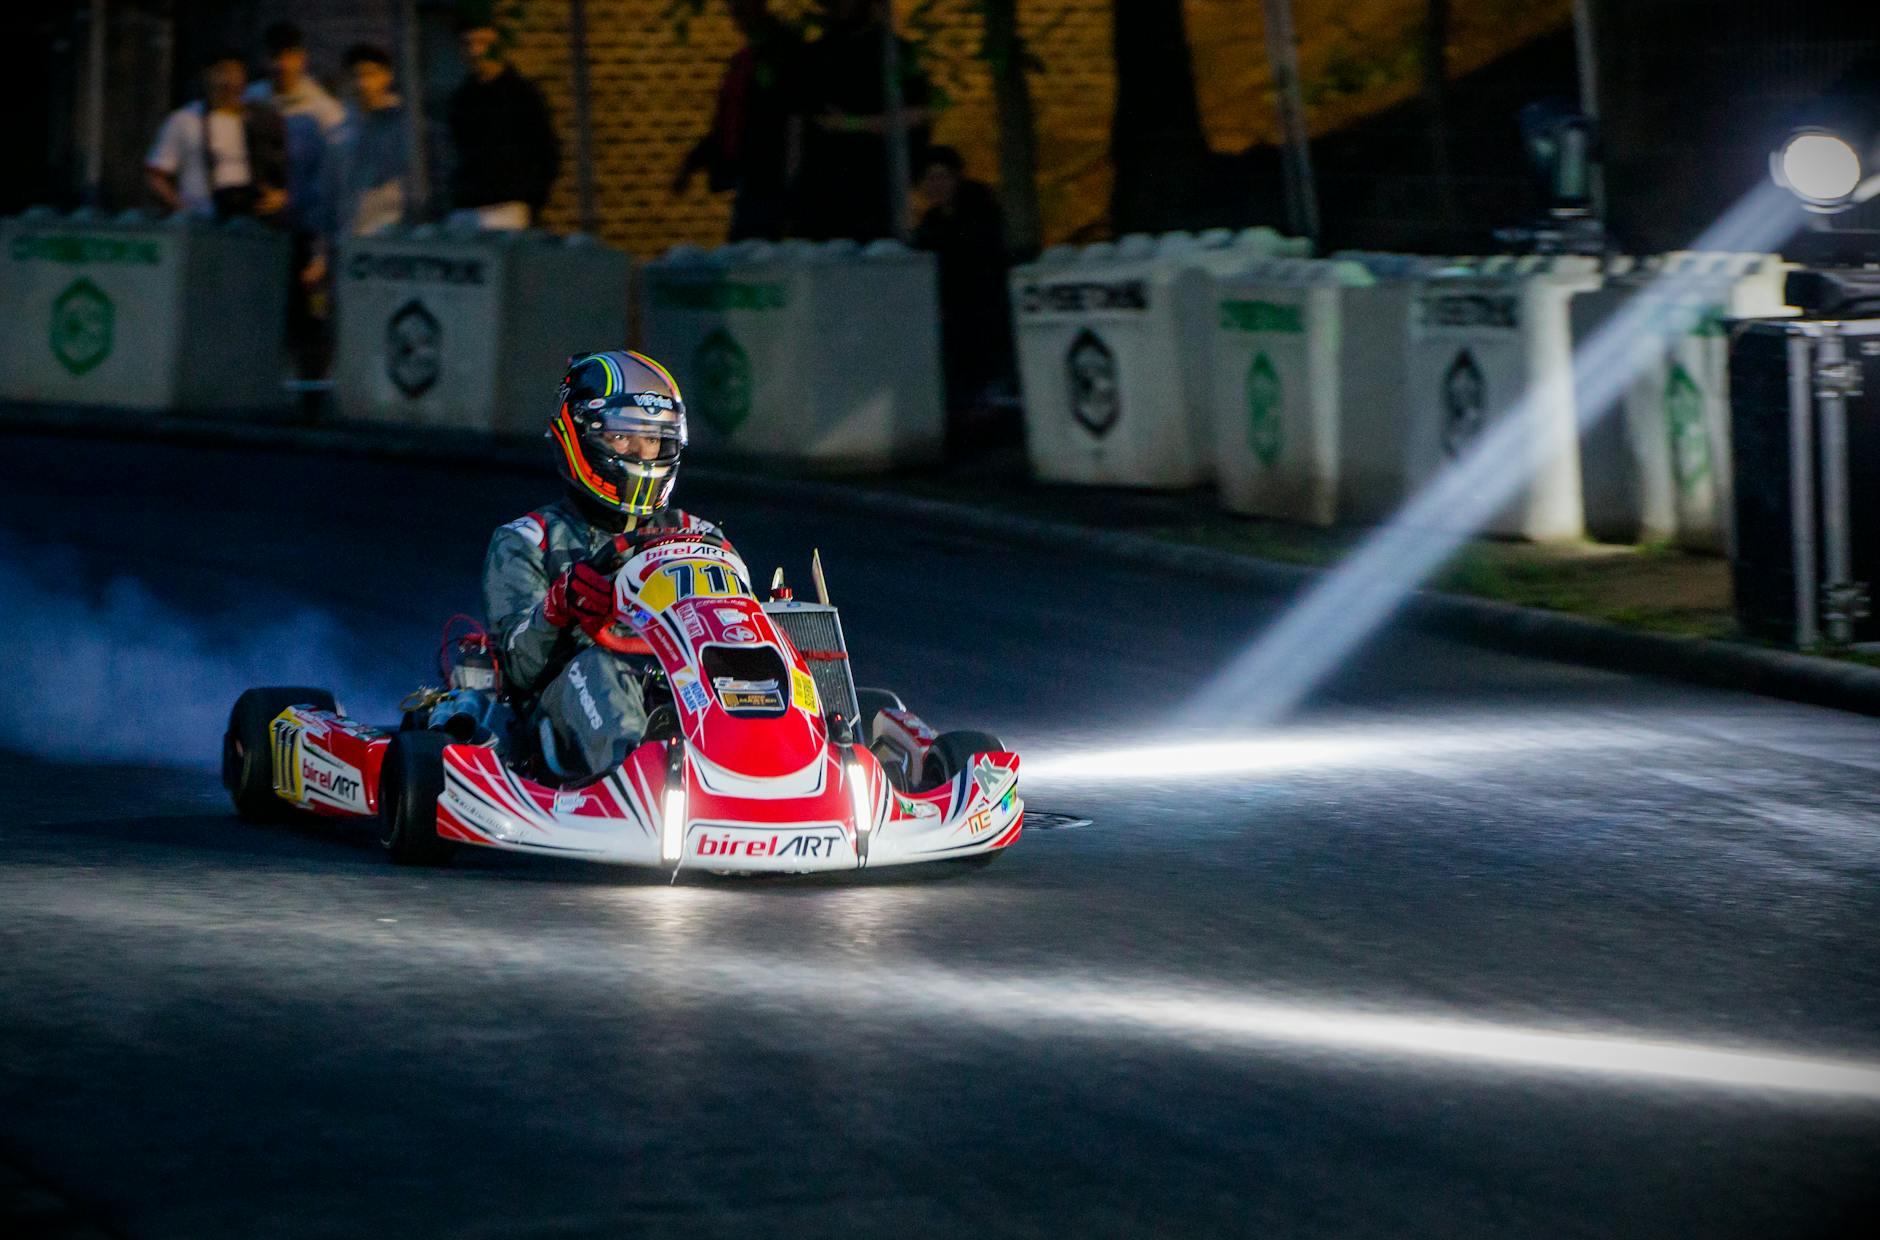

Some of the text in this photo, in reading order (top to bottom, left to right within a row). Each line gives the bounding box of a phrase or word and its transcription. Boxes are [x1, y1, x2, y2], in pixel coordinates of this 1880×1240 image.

[645, 545, 727, 562] birelART
[663, 564, 751, 602] 711
[303, 757, 360, 801] birelART
[697, 833, 841, 857] birelART
